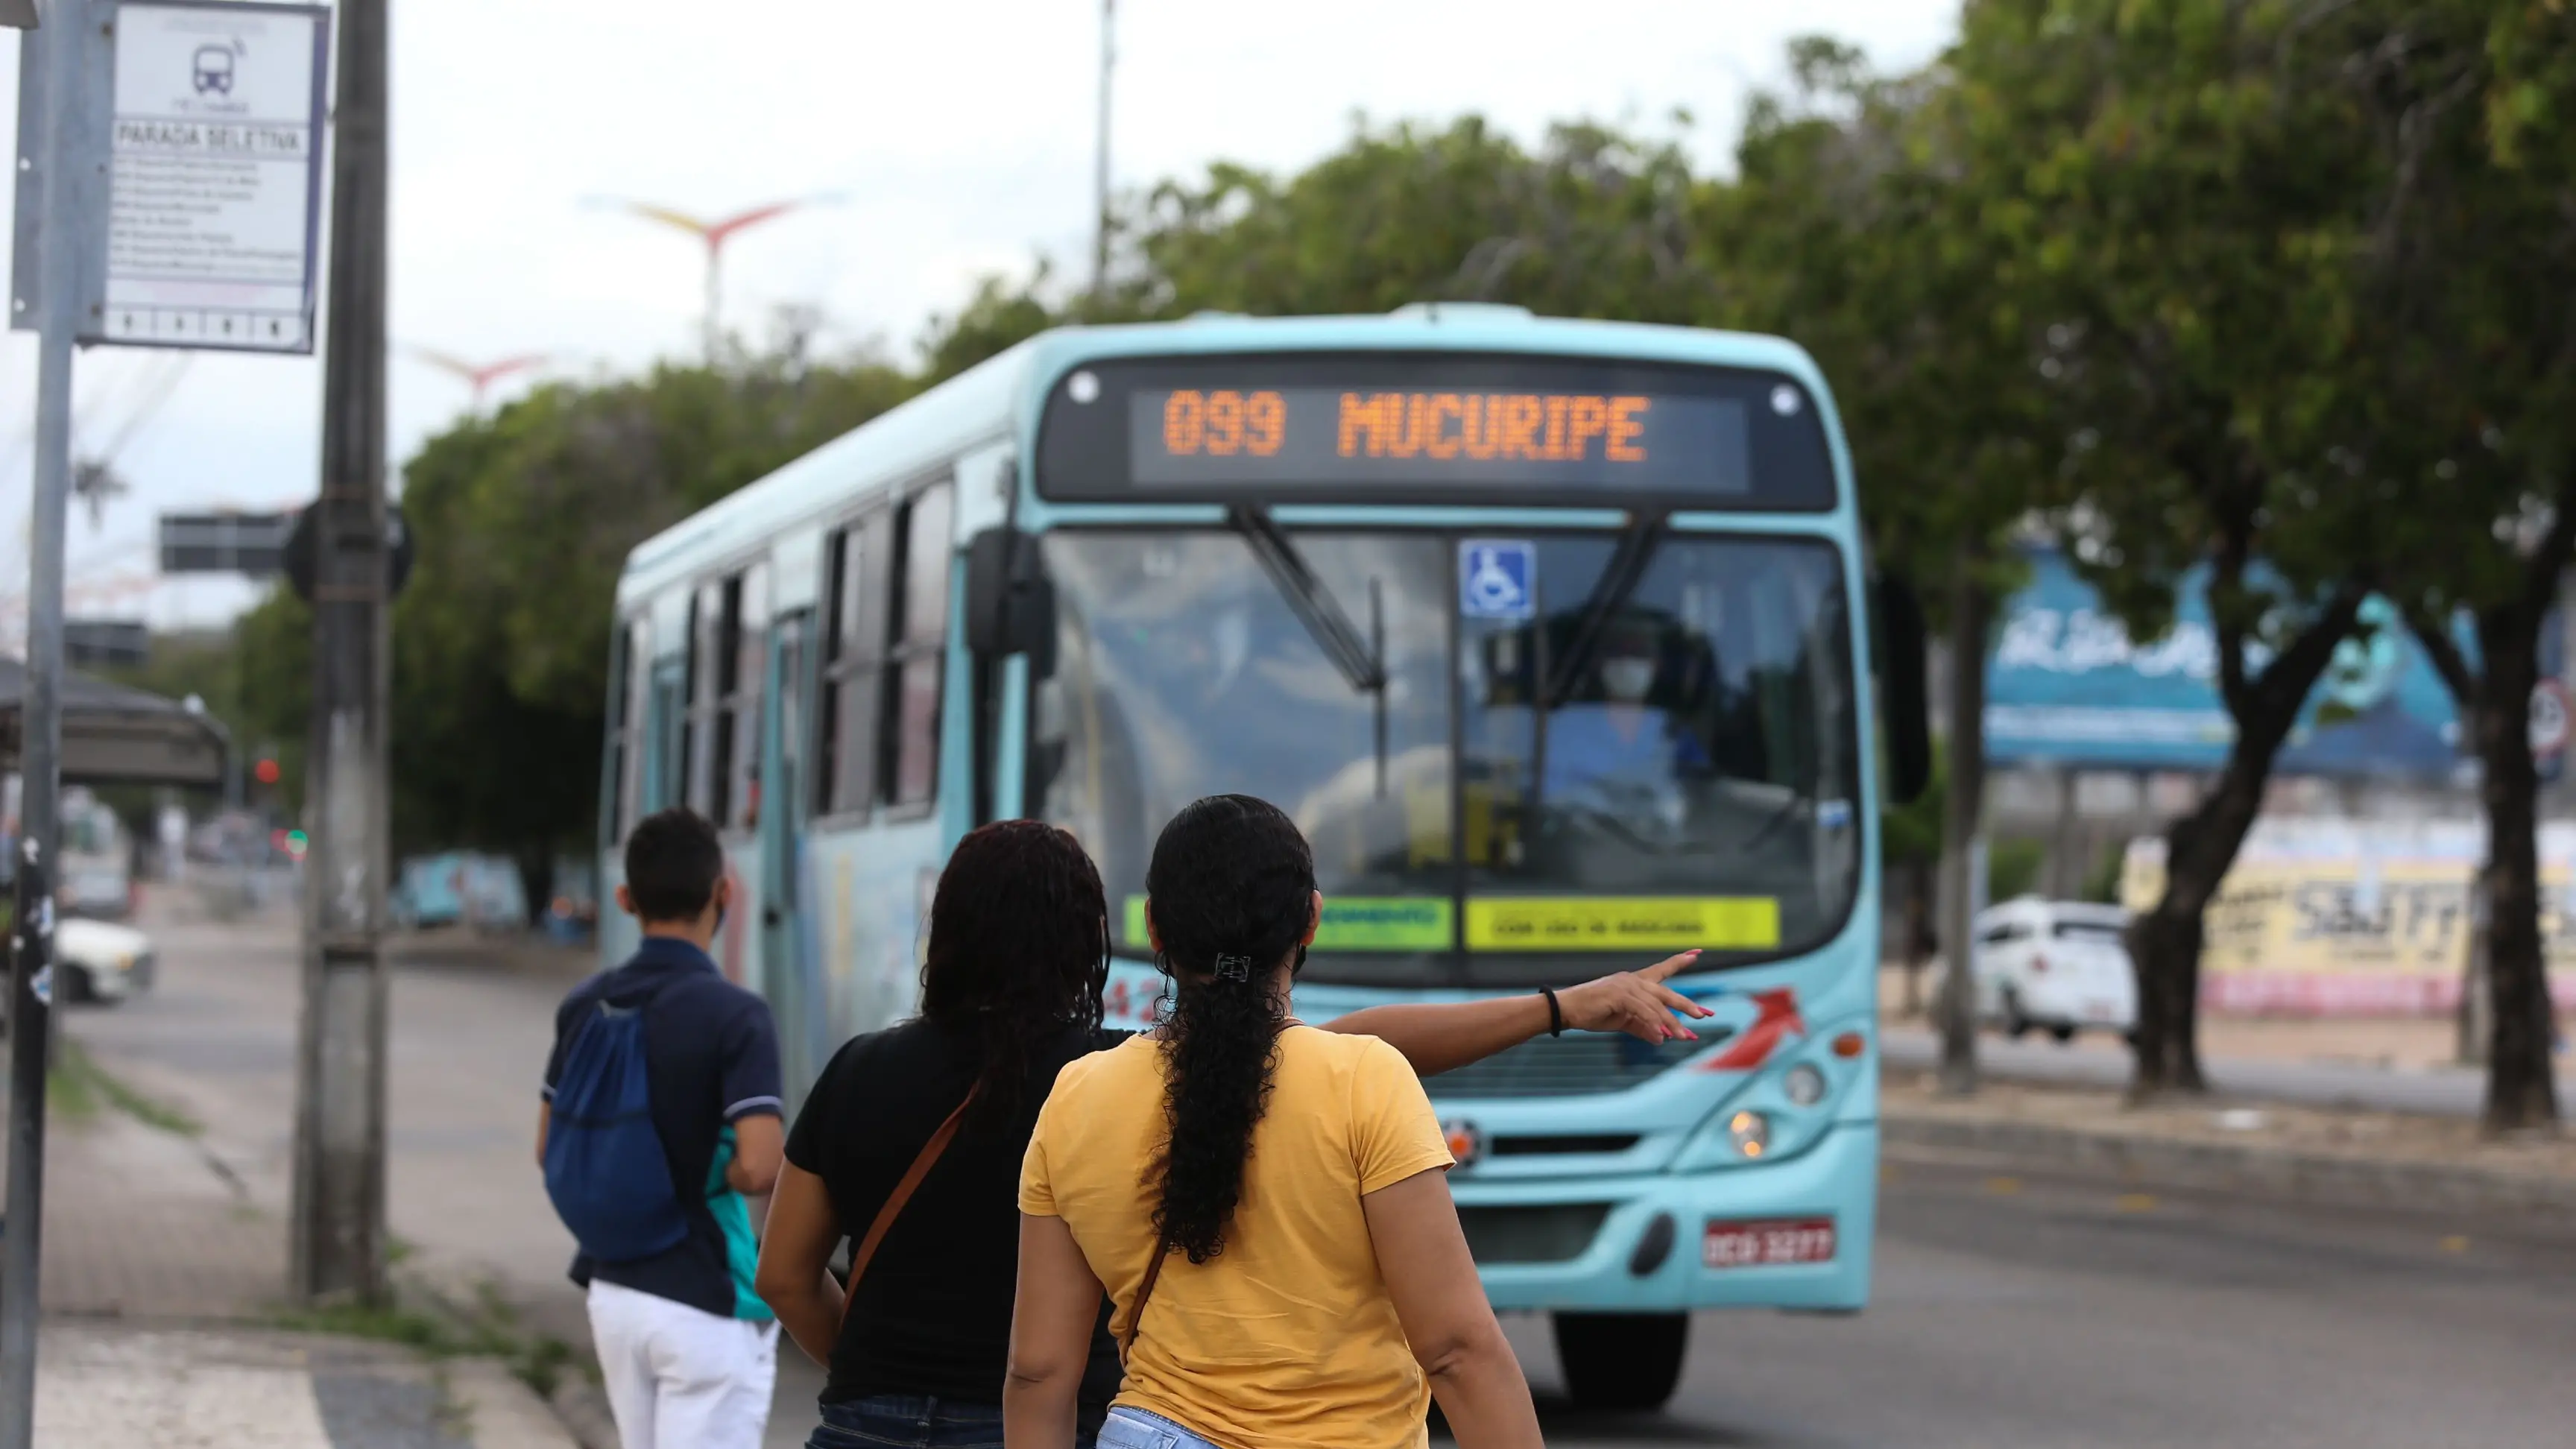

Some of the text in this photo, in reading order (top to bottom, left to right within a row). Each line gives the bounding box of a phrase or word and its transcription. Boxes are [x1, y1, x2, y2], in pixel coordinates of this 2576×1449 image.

[118, 123, 300, 151] PARADA SELETIVA
[1164, 390, 1651, 461] 099 MUCURIPE
